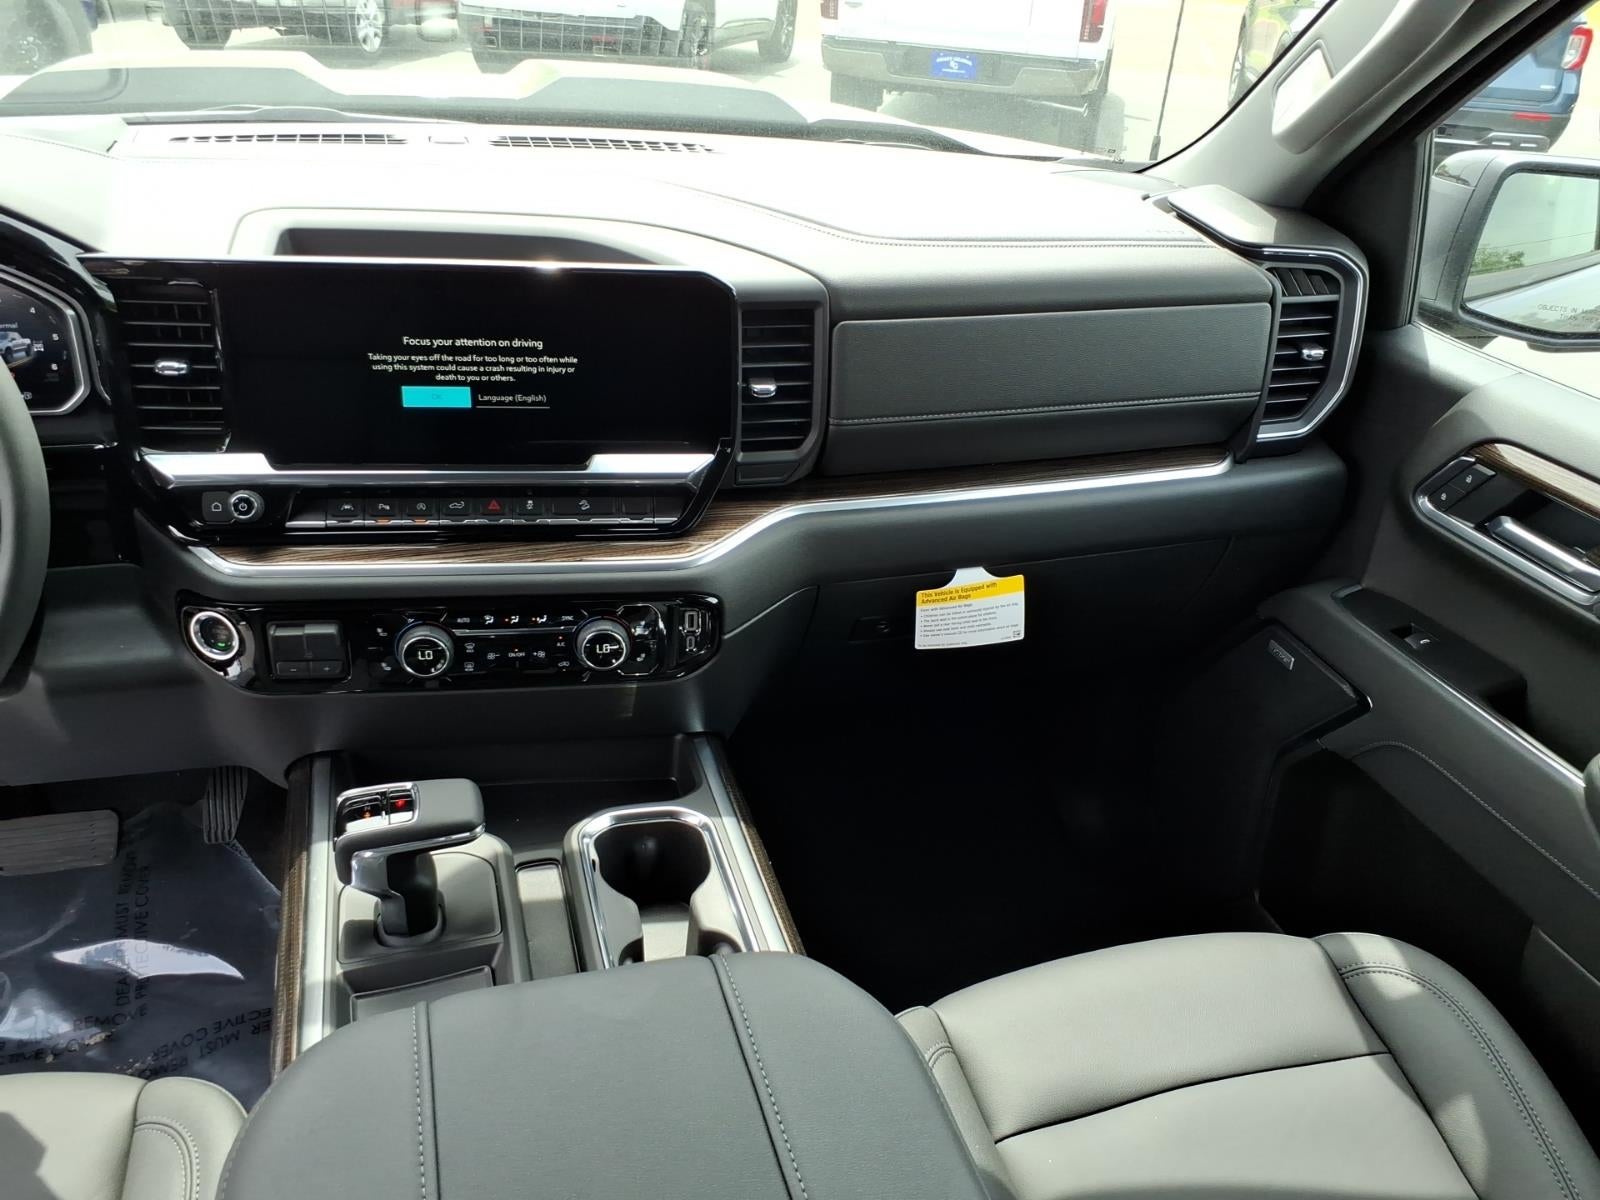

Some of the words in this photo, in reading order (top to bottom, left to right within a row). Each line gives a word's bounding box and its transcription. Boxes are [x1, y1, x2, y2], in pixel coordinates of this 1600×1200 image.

[30, 306, 36, 314] 4
[52, 333, 59, 341] 5
[403, 336, 431, 346] Focus
[432, 339, 453, 348] your
[455, 338, 497, 347] attention
[511, 338, 543, 350] driving
[368, 353, 393, 362] Taking
[498, 355, 515, 364] long
[51, 363, 58, 371] 6
[372, 364, 393, 372] using
[393, 363, 408, 371] this
[506, 365, 537, 374] resulting
[546, 366, 566, 374] injury
[435, 373, 457, 381] death
[478, 394, 514, 403] Language
[514, 394, 547, 403] (English)
[934, 589, 954, 597] Vehicle
[960, 584, 985, 594] Equipped
